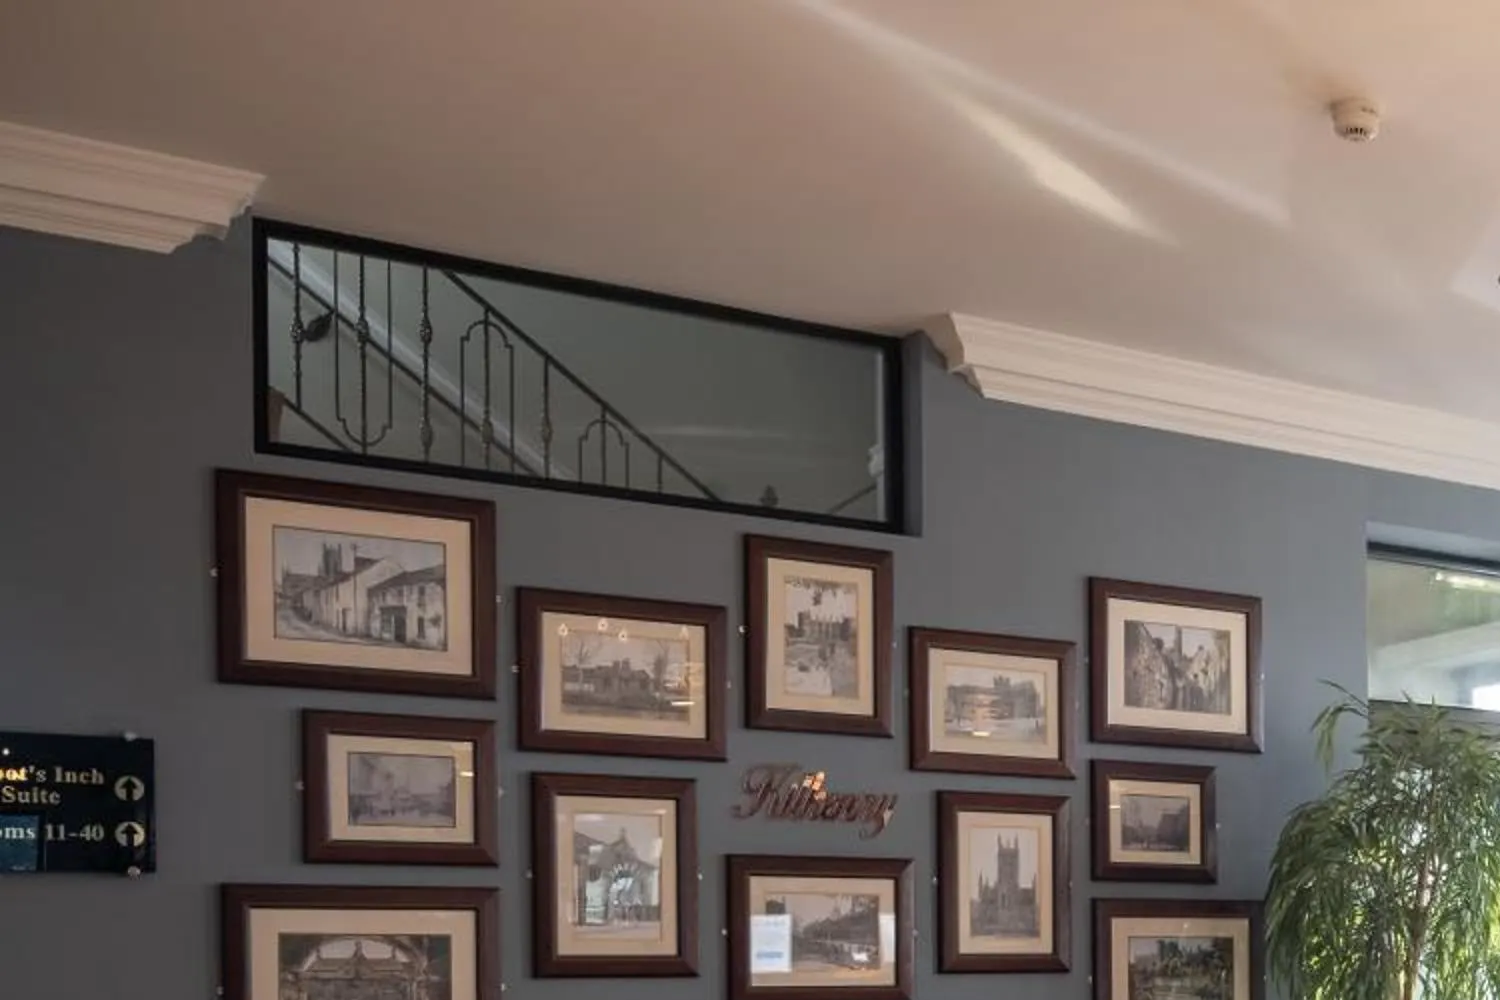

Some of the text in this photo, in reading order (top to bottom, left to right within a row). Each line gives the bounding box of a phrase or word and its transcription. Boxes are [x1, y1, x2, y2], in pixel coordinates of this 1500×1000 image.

[54, 766, 105, 785] Inch
[1, 785, 62, 805] Suite
[732, 762, 898, 840] Kilkenny
[0, 827, 36, 840] ms
